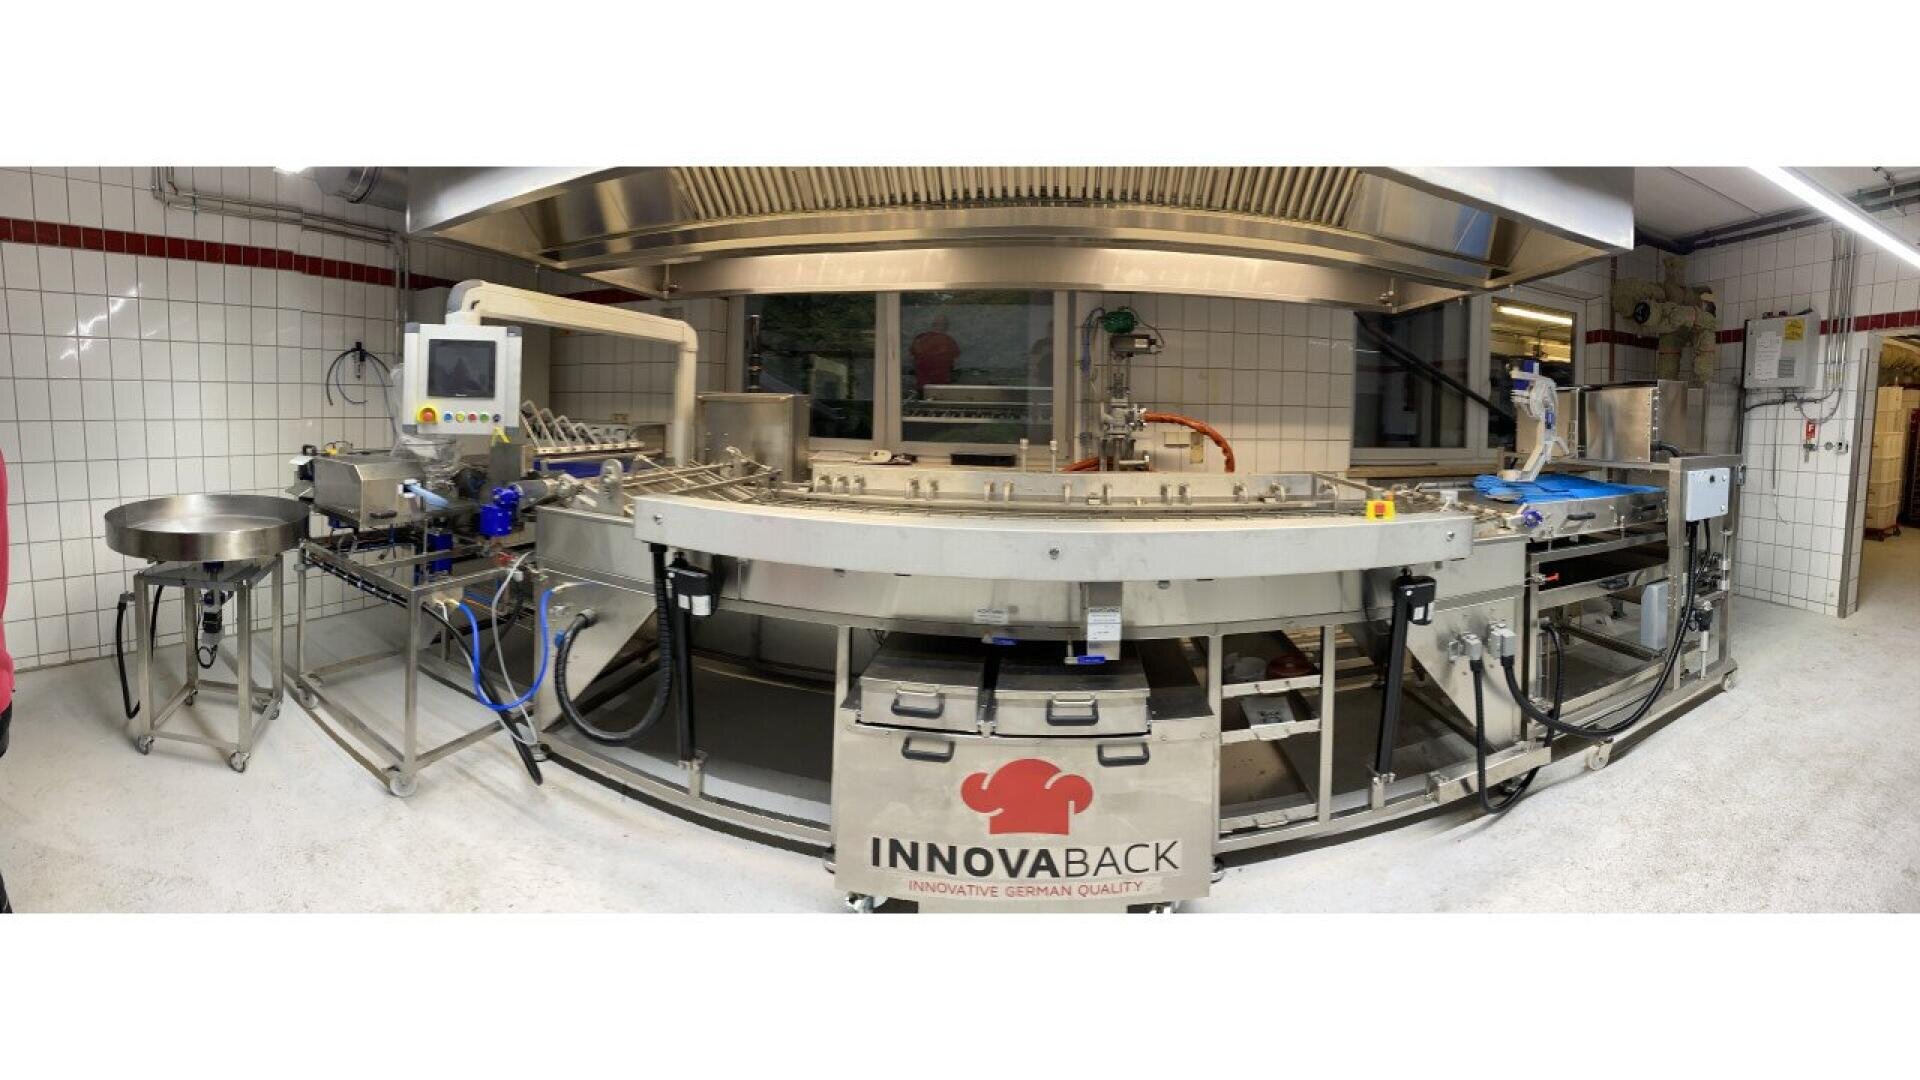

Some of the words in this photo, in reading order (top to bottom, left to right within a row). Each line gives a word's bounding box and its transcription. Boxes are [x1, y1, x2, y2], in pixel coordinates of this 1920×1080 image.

[872, 837, 1179, 878] INNOVABACK
[908, 880, 998, 897] INNOVATIVE
[1005, 886, 1072, 897] GERMAN
[1078, 881, 1143, 897] QUALITY
